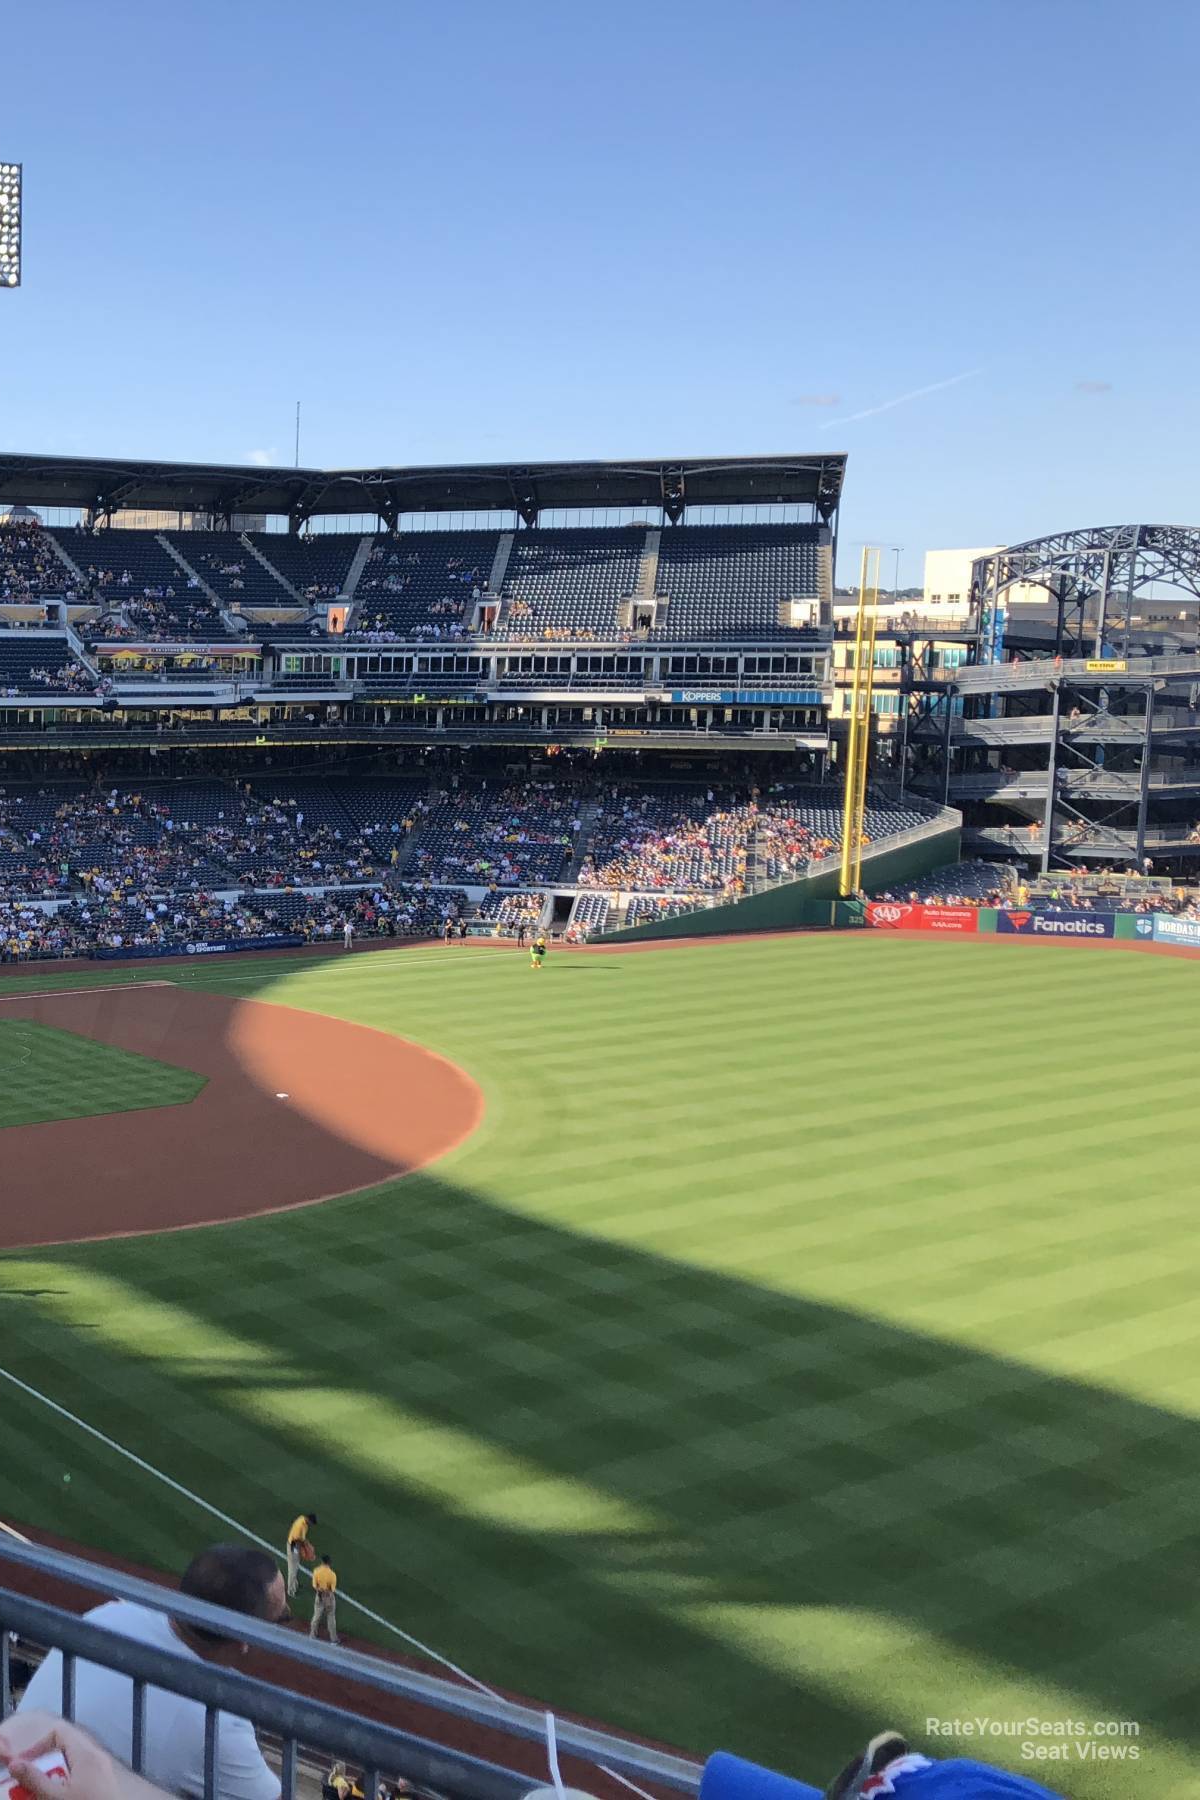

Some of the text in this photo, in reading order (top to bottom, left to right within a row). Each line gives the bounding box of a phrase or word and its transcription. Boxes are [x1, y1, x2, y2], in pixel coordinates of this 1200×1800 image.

[682, 691, 721, 702] KOPPERS
[877, 907, 898, 921] AAA
[931, 921, 963, 929] AAA.com
[1033, 916, 1105, 934] Fanatics
